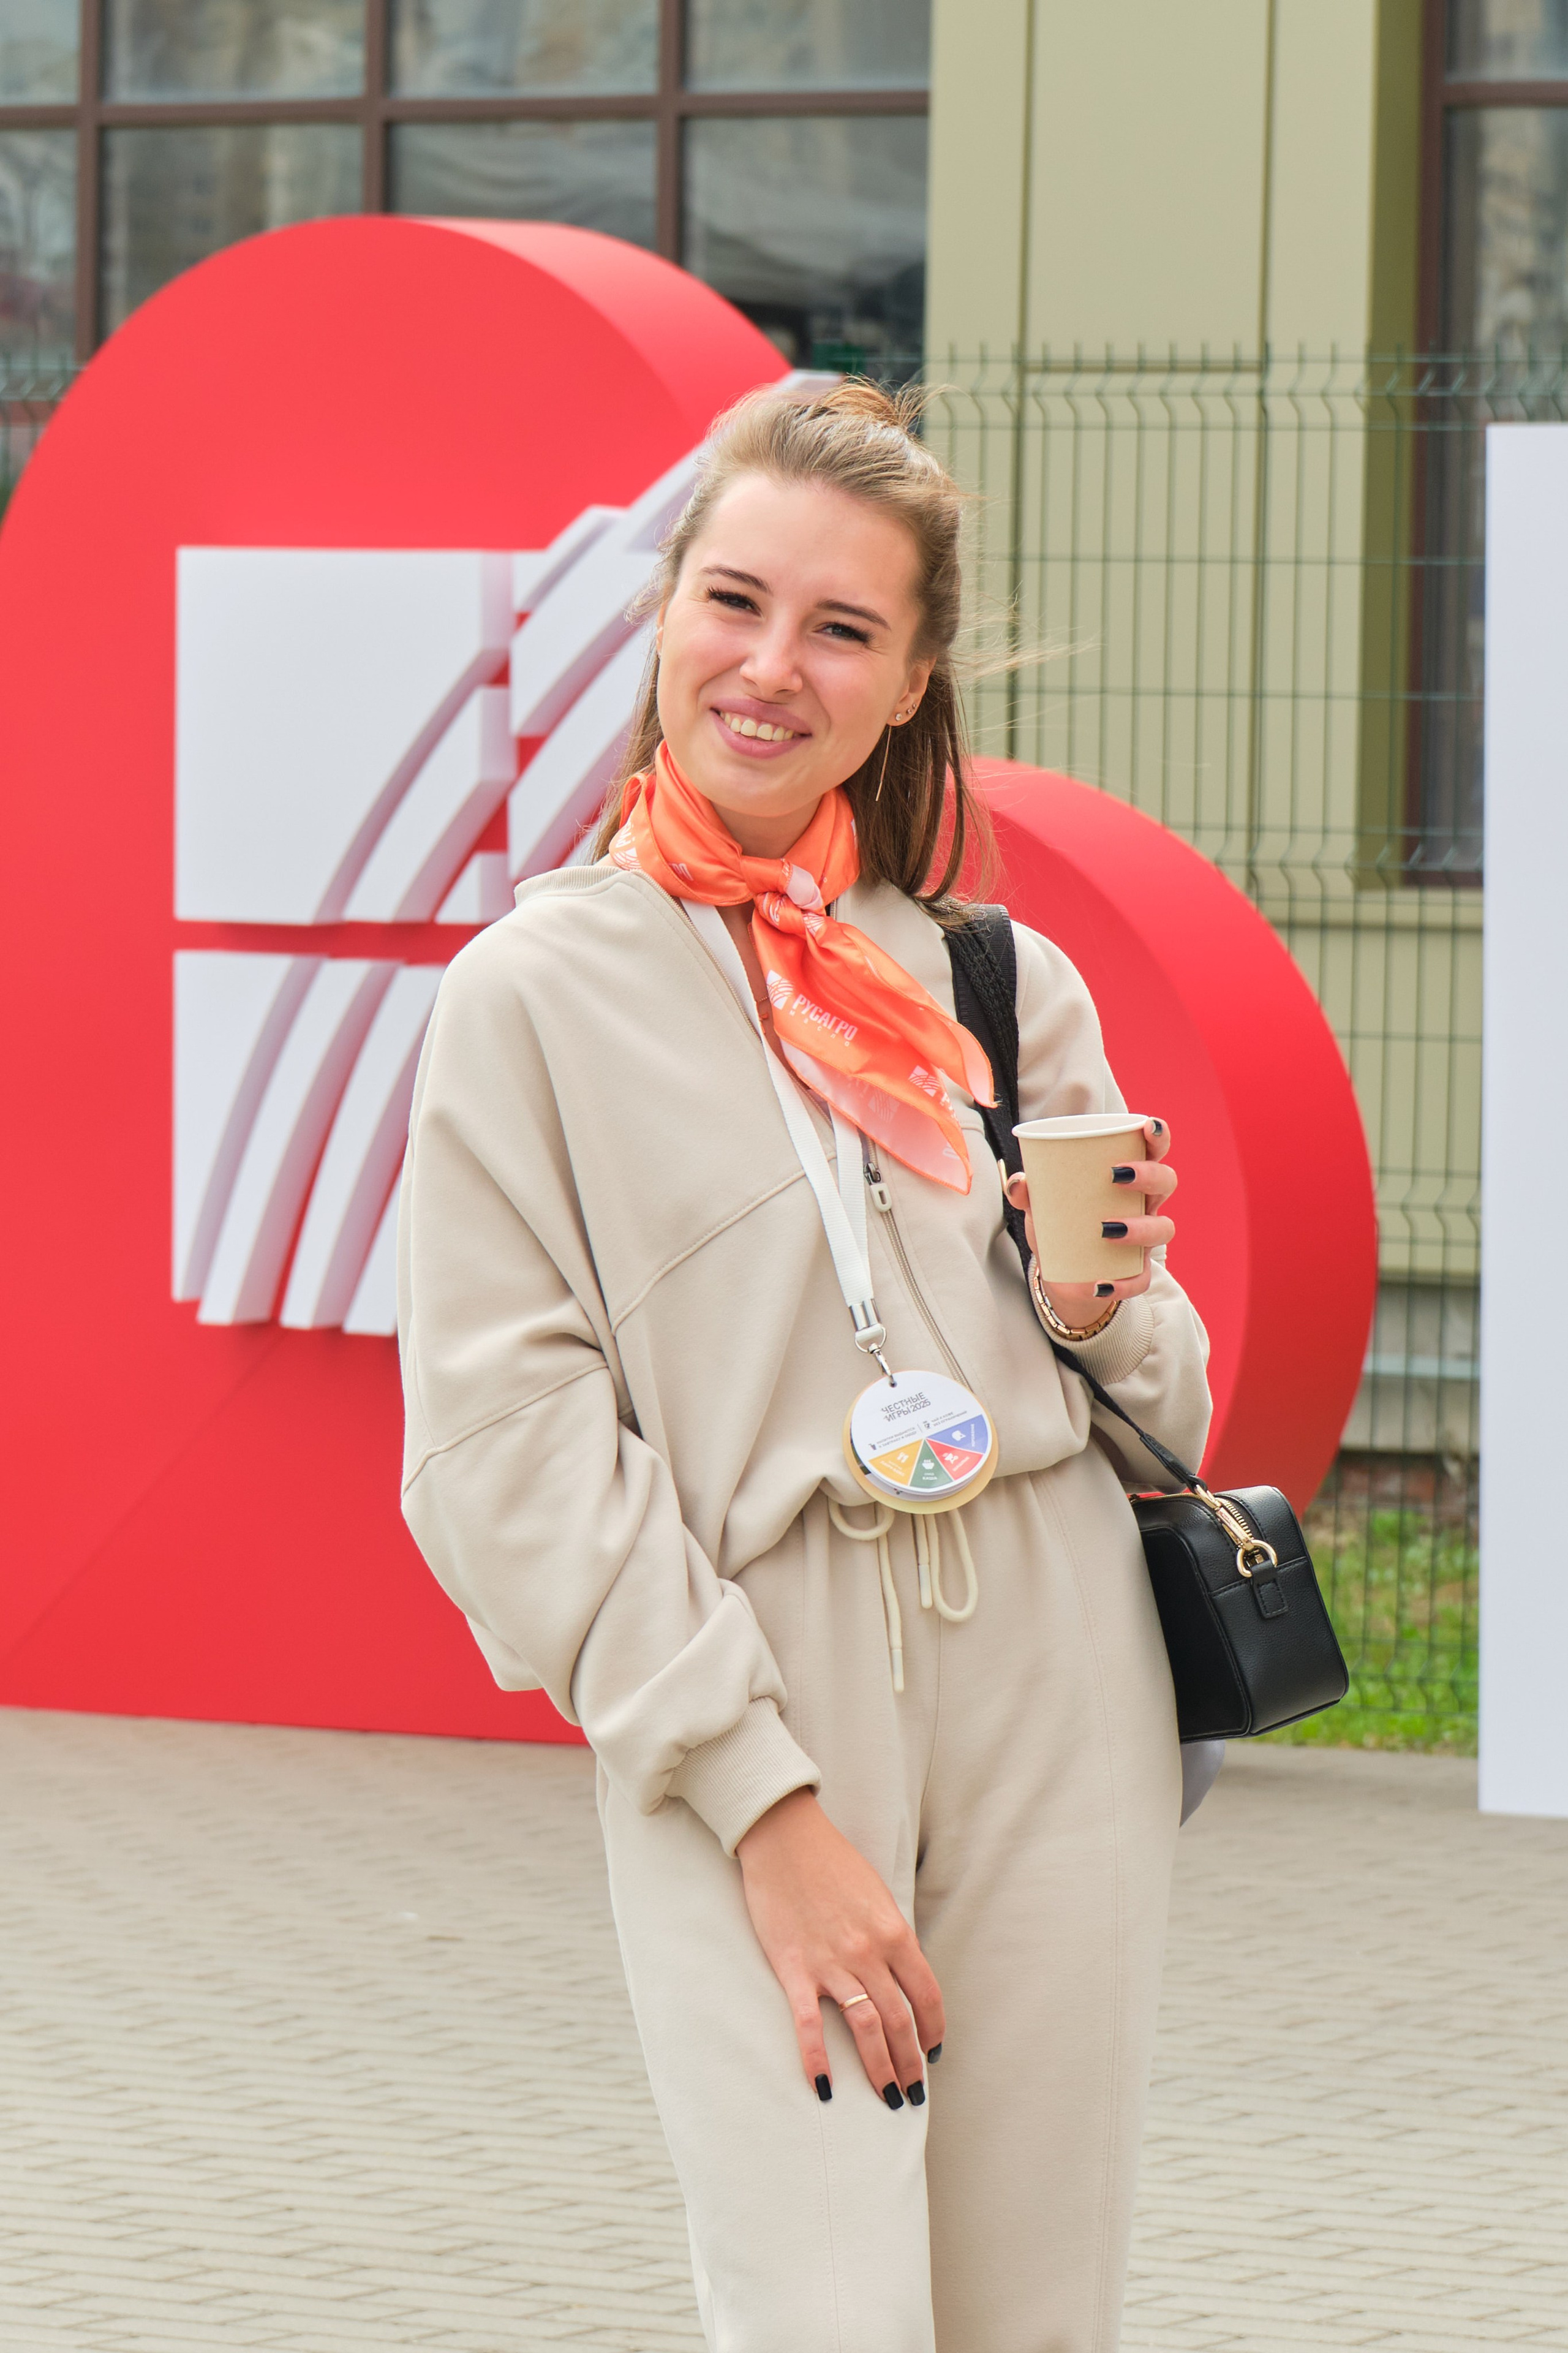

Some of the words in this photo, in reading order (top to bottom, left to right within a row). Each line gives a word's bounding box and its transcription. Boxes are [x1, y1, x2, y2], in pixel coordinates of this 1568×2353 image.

[792, 994, 859, 1041] РУСАГРО
[881, 1392, 925, 1414] ЧЕСТНЫЕ
[884, 1407, 911, 1422] ИГРЫ
[910, 1399, 931, 1412] 2025
